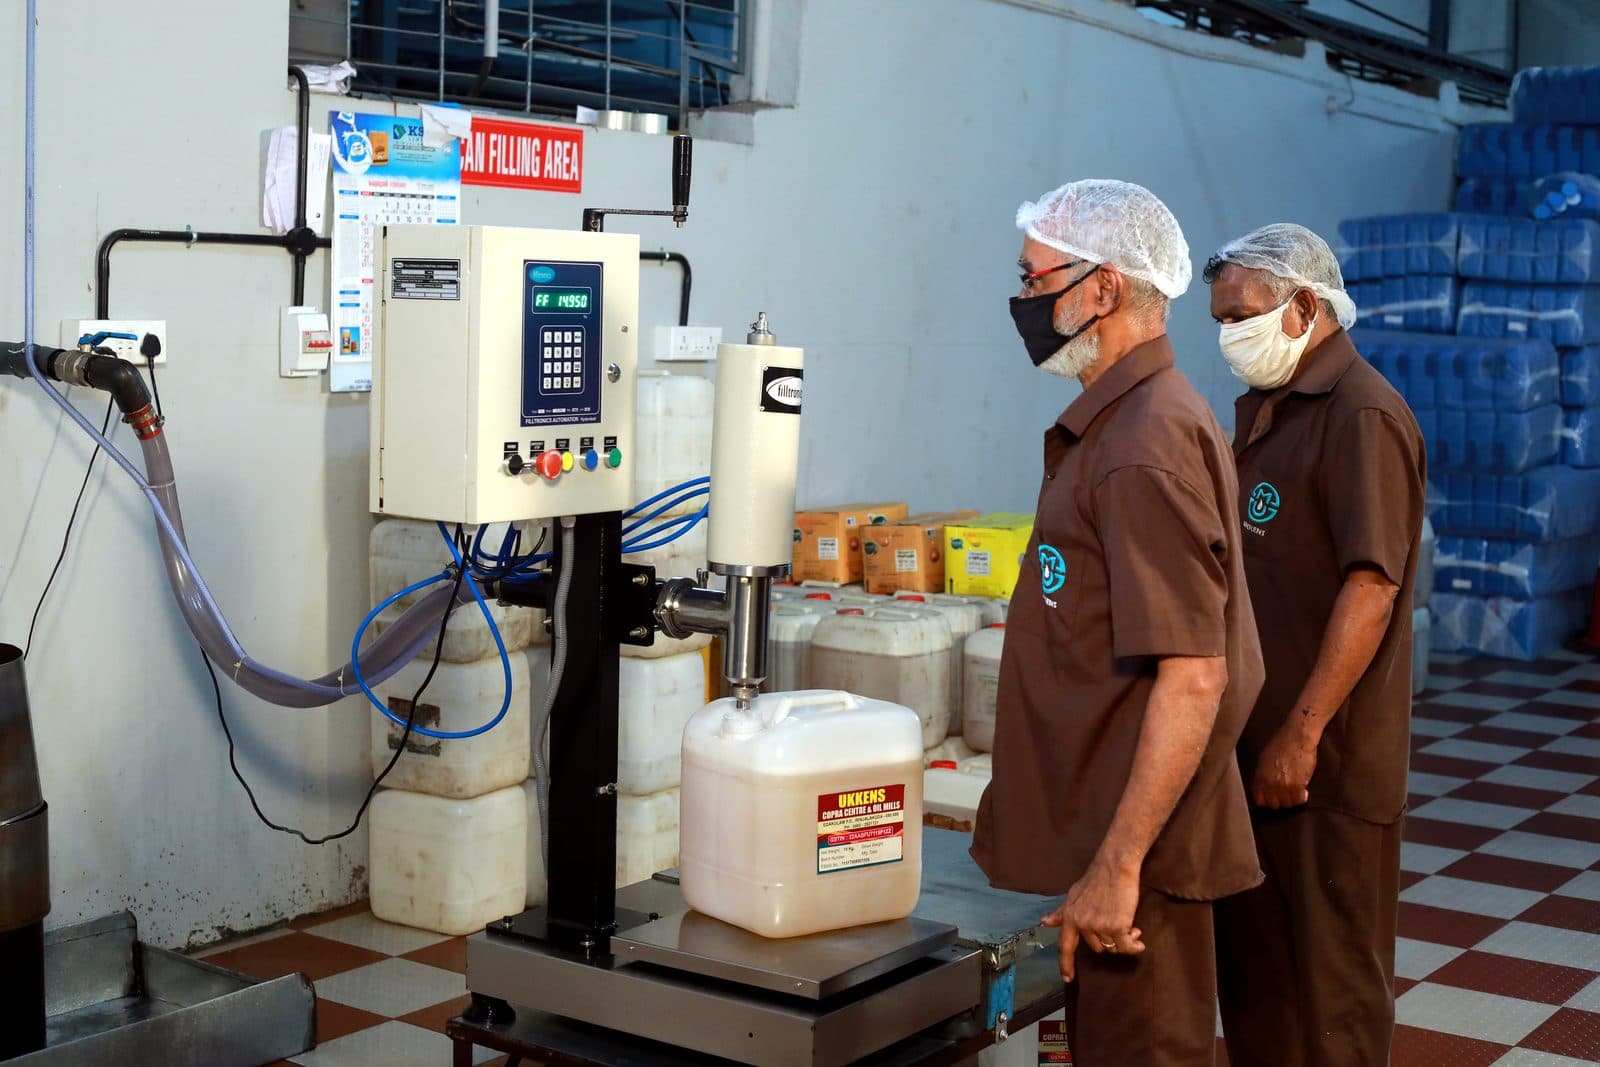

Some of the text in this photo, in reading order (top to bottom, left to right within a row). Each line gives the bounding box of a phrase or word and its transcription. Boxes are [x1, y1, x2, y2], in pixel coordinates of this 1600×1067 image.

[488, 133, 541, 178] FILLING
[543, 139, 579, 182] AREA
[535, 294, 549, 306] FF
[838, 788, 886, 808] UKKENS
[822, 800, 901, 820] COPRA CENTRE & OIL MILLS
